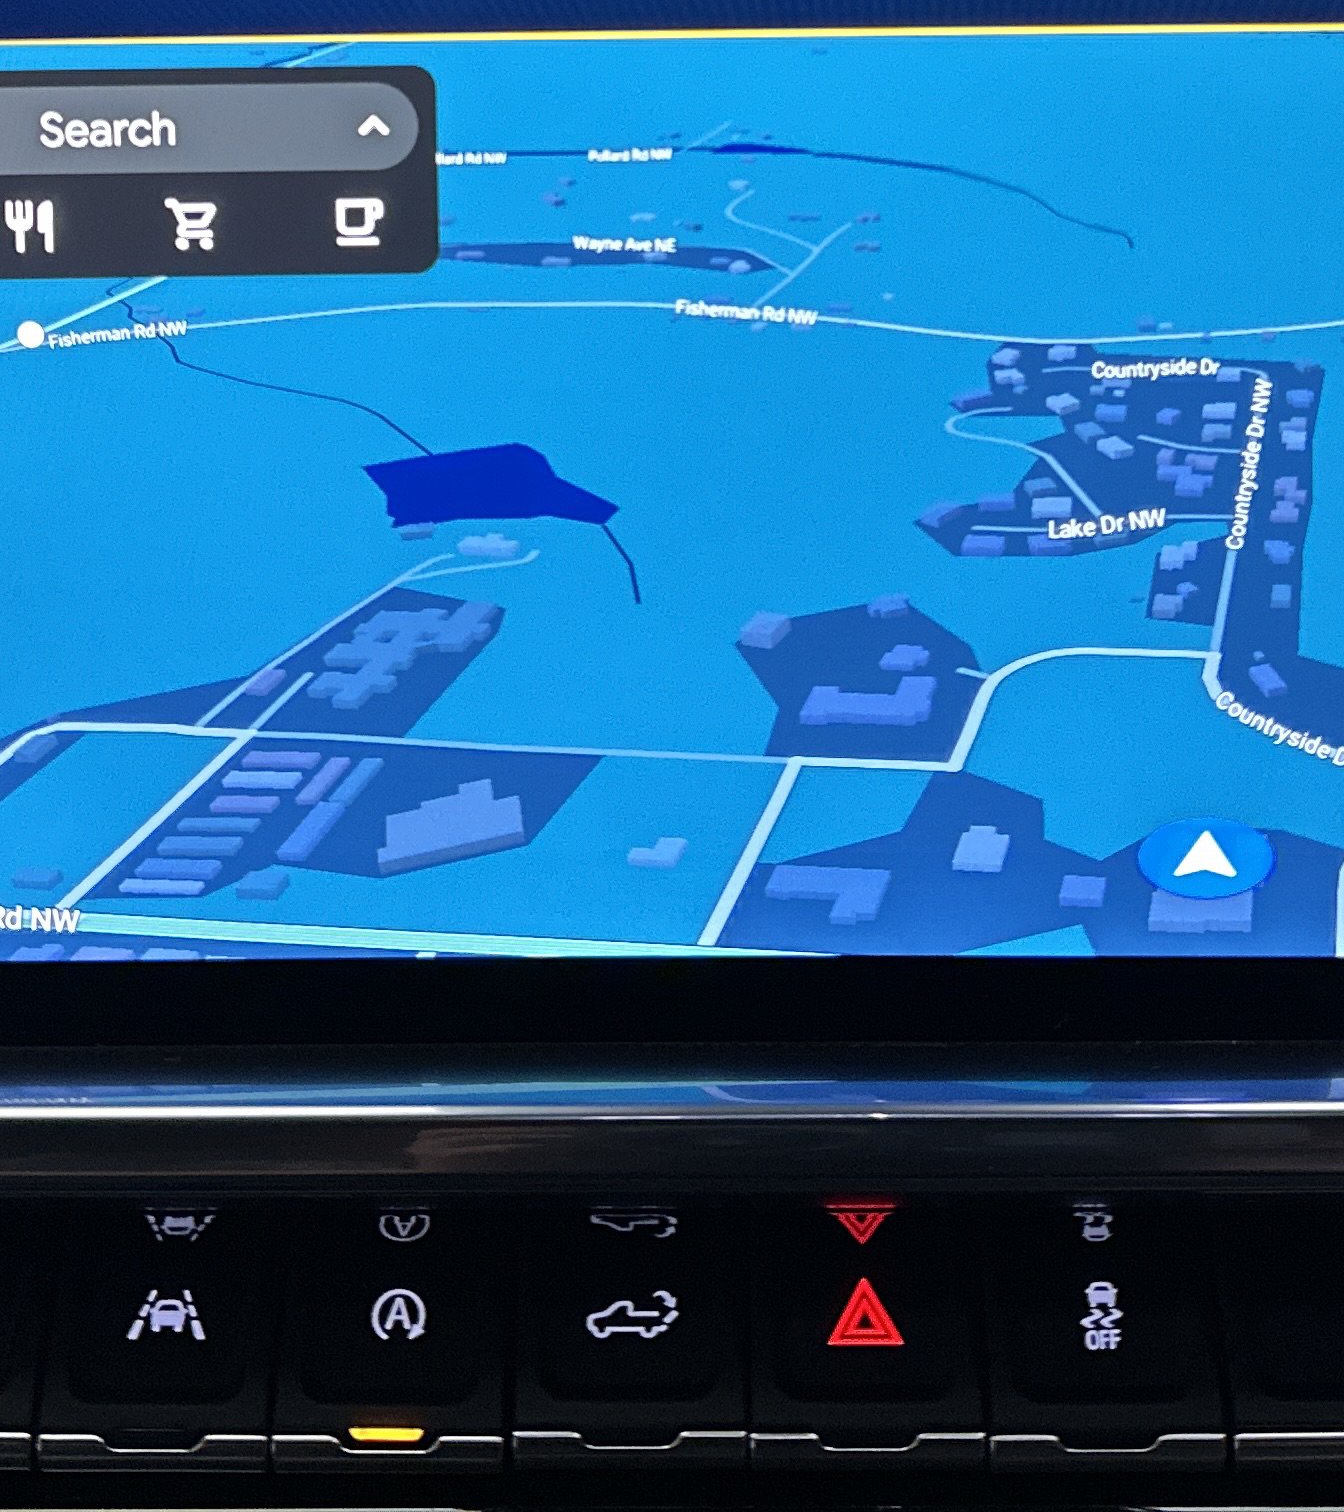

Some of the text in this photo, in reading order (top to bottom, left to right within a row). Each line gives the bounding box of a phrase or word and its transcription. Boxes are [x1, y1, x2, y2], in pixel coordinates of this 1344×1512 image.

[39, 109, 177, 150] Search
[464, 151, 483, 165] Rd
[483, 151, 508, 164] NW
[586, 146, 674, 163] Pollard Rd NW
[571, 234, 678, 255] Wayne Ave NE
[674, 298, 819, 326] Fisherman Rd NW
[47, 319, 188, 350] Fisherman Rd NW
[1091, 356, 1221, 381] Countryside Dr
[1224, 377, 1273, 551] Countryside Dr NW
[1048, 507, 1167, 540] Lake Dr NW
[1215, 691, 1333, 760] Countryside
[30, 907, 80, 934] NW
[1084, 1328, 1122, 1351] OFF
